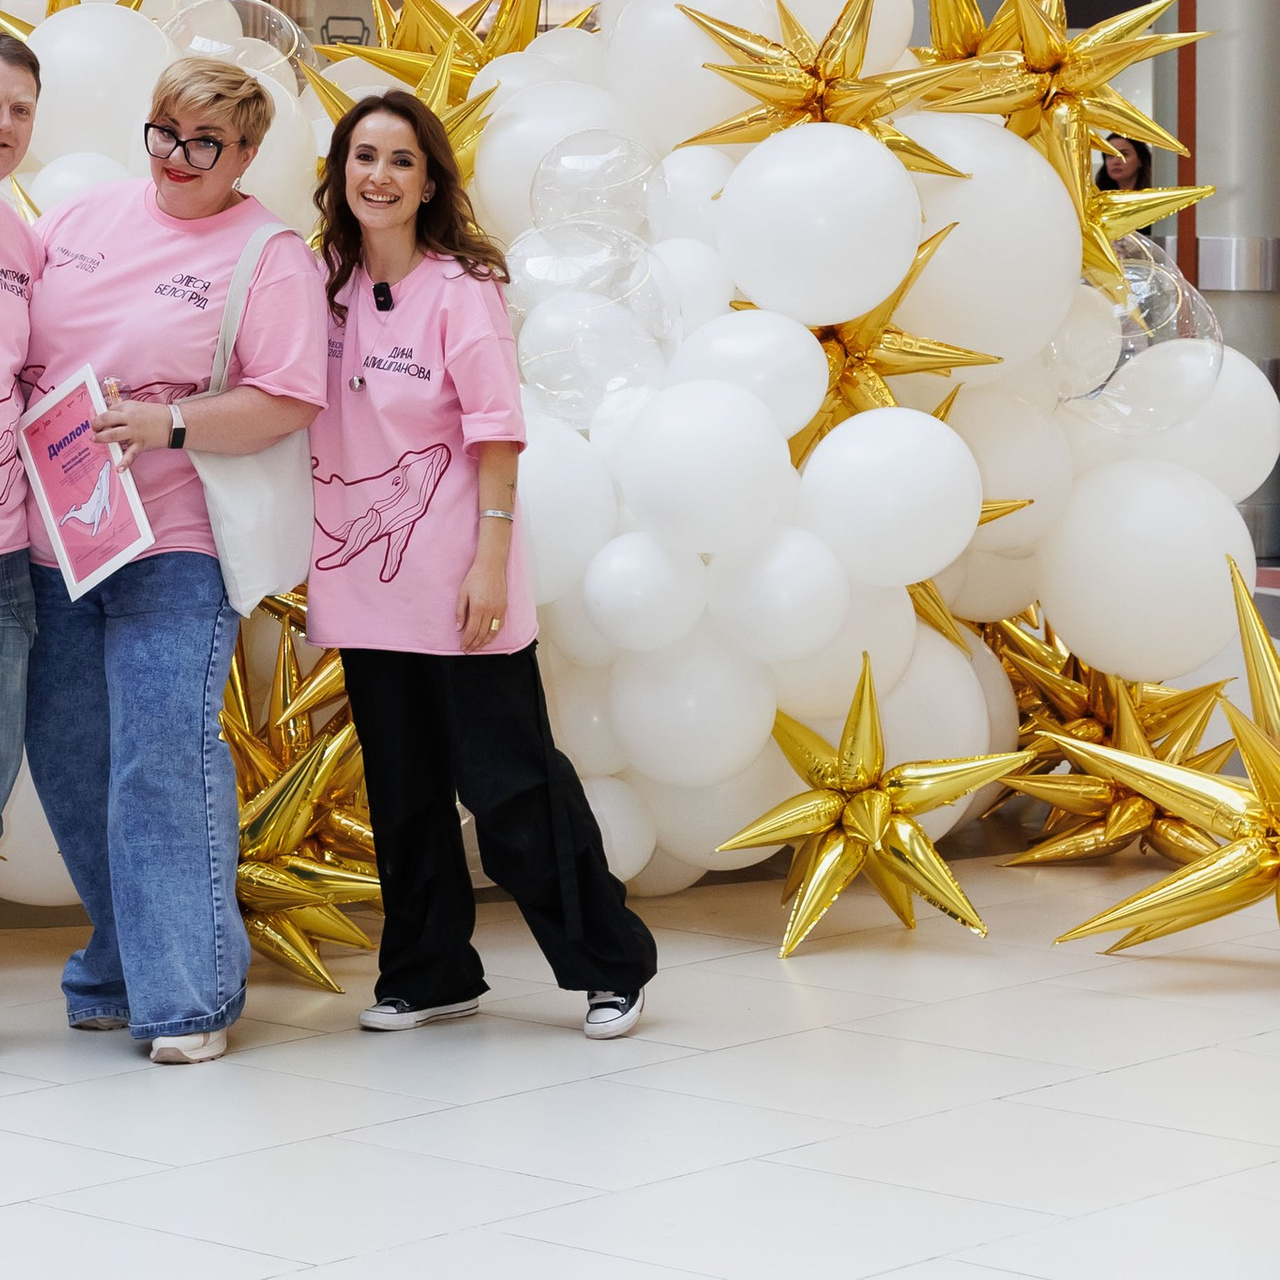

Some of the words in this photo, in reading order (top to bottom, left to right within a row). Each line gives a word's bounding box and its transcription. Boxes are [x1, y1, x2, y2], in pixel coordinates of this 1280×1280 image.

[75, 261, 96, 273] 2025
[172, 274, 211, 292] ОЛЕСЯ
[154, 284, 208, 309] БЕЛОГРУД
[388, 346, 413, 359] ДИНА
[47, 419, 91, 461] Диплом
